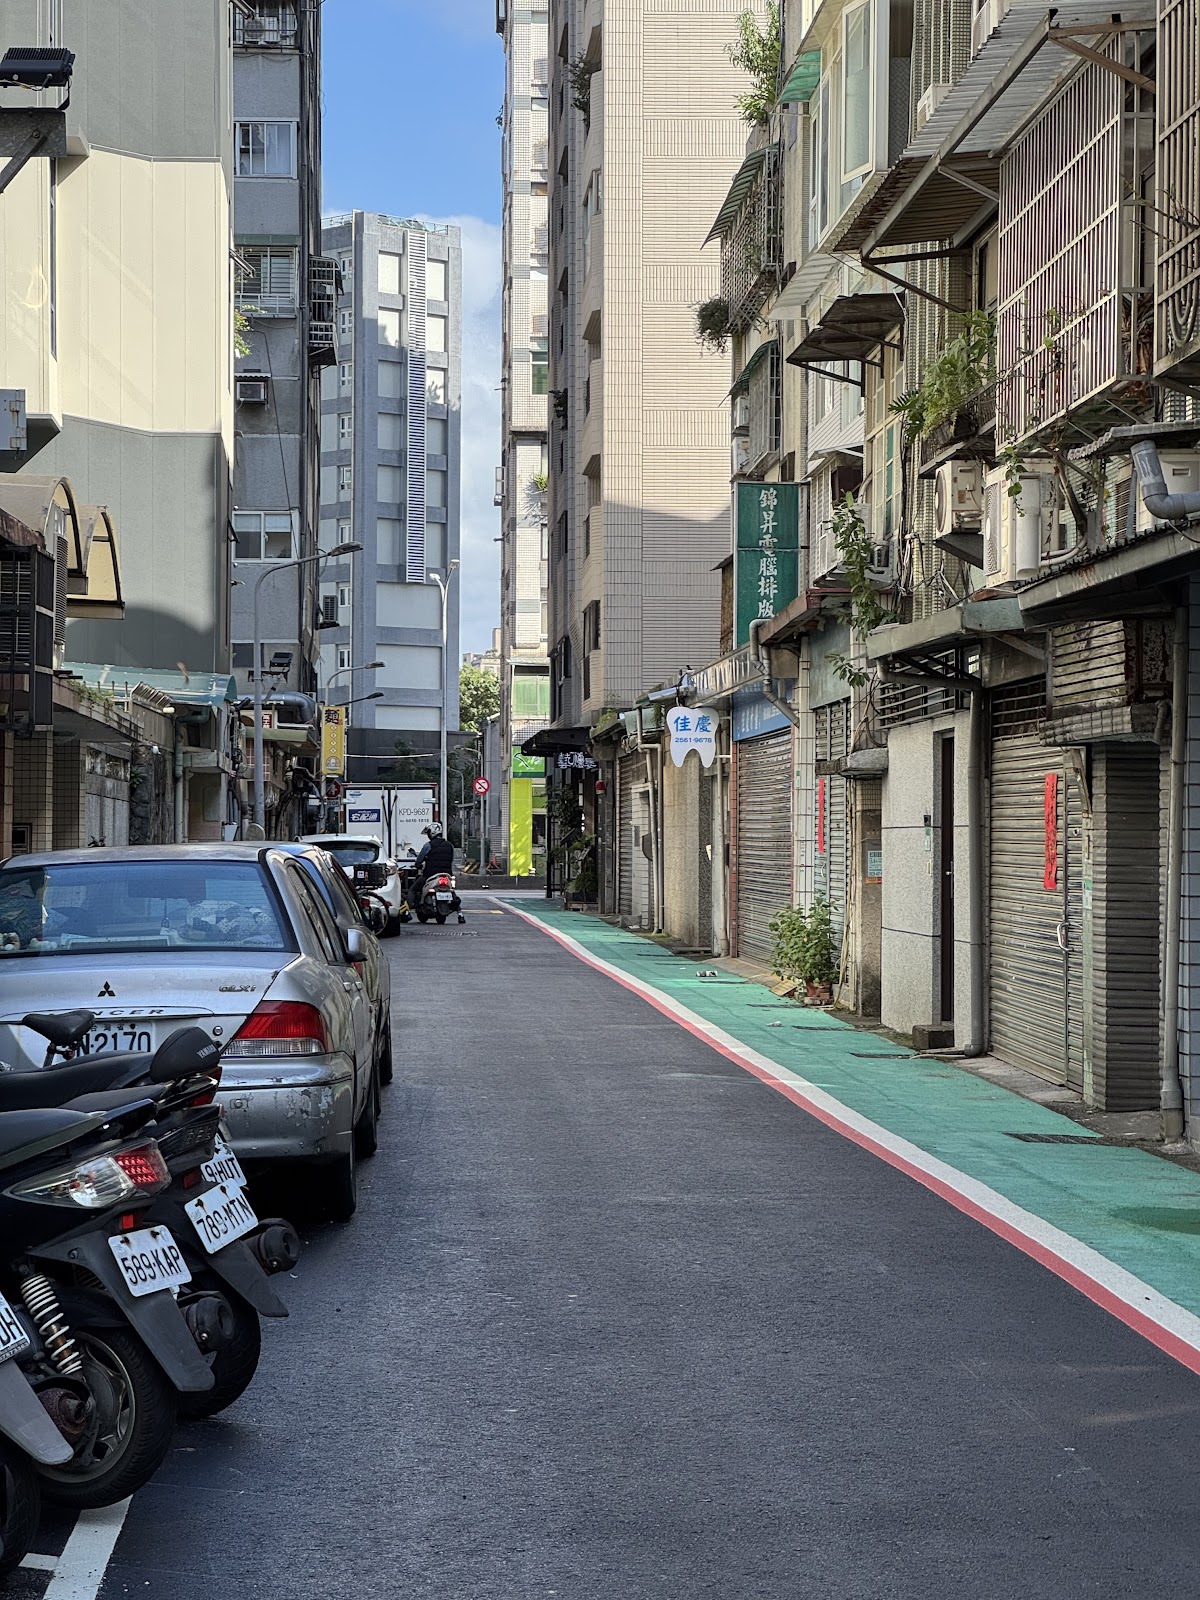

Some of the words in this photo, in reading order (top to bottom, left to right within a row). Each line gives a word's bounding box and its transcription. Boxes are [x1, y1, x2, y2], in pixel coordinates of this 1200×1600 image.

[673, 714, 712, 733] 佳慶
[398, 808, 430, 816] KPD-9687
[76, 1031, 151, 1058] N-2170
[204, 1157, 241, 1183] 9-HUT
[196, 1194, 254, 1244] 789-MTN
[120, 1245, 183, 1285] 589-KAP
